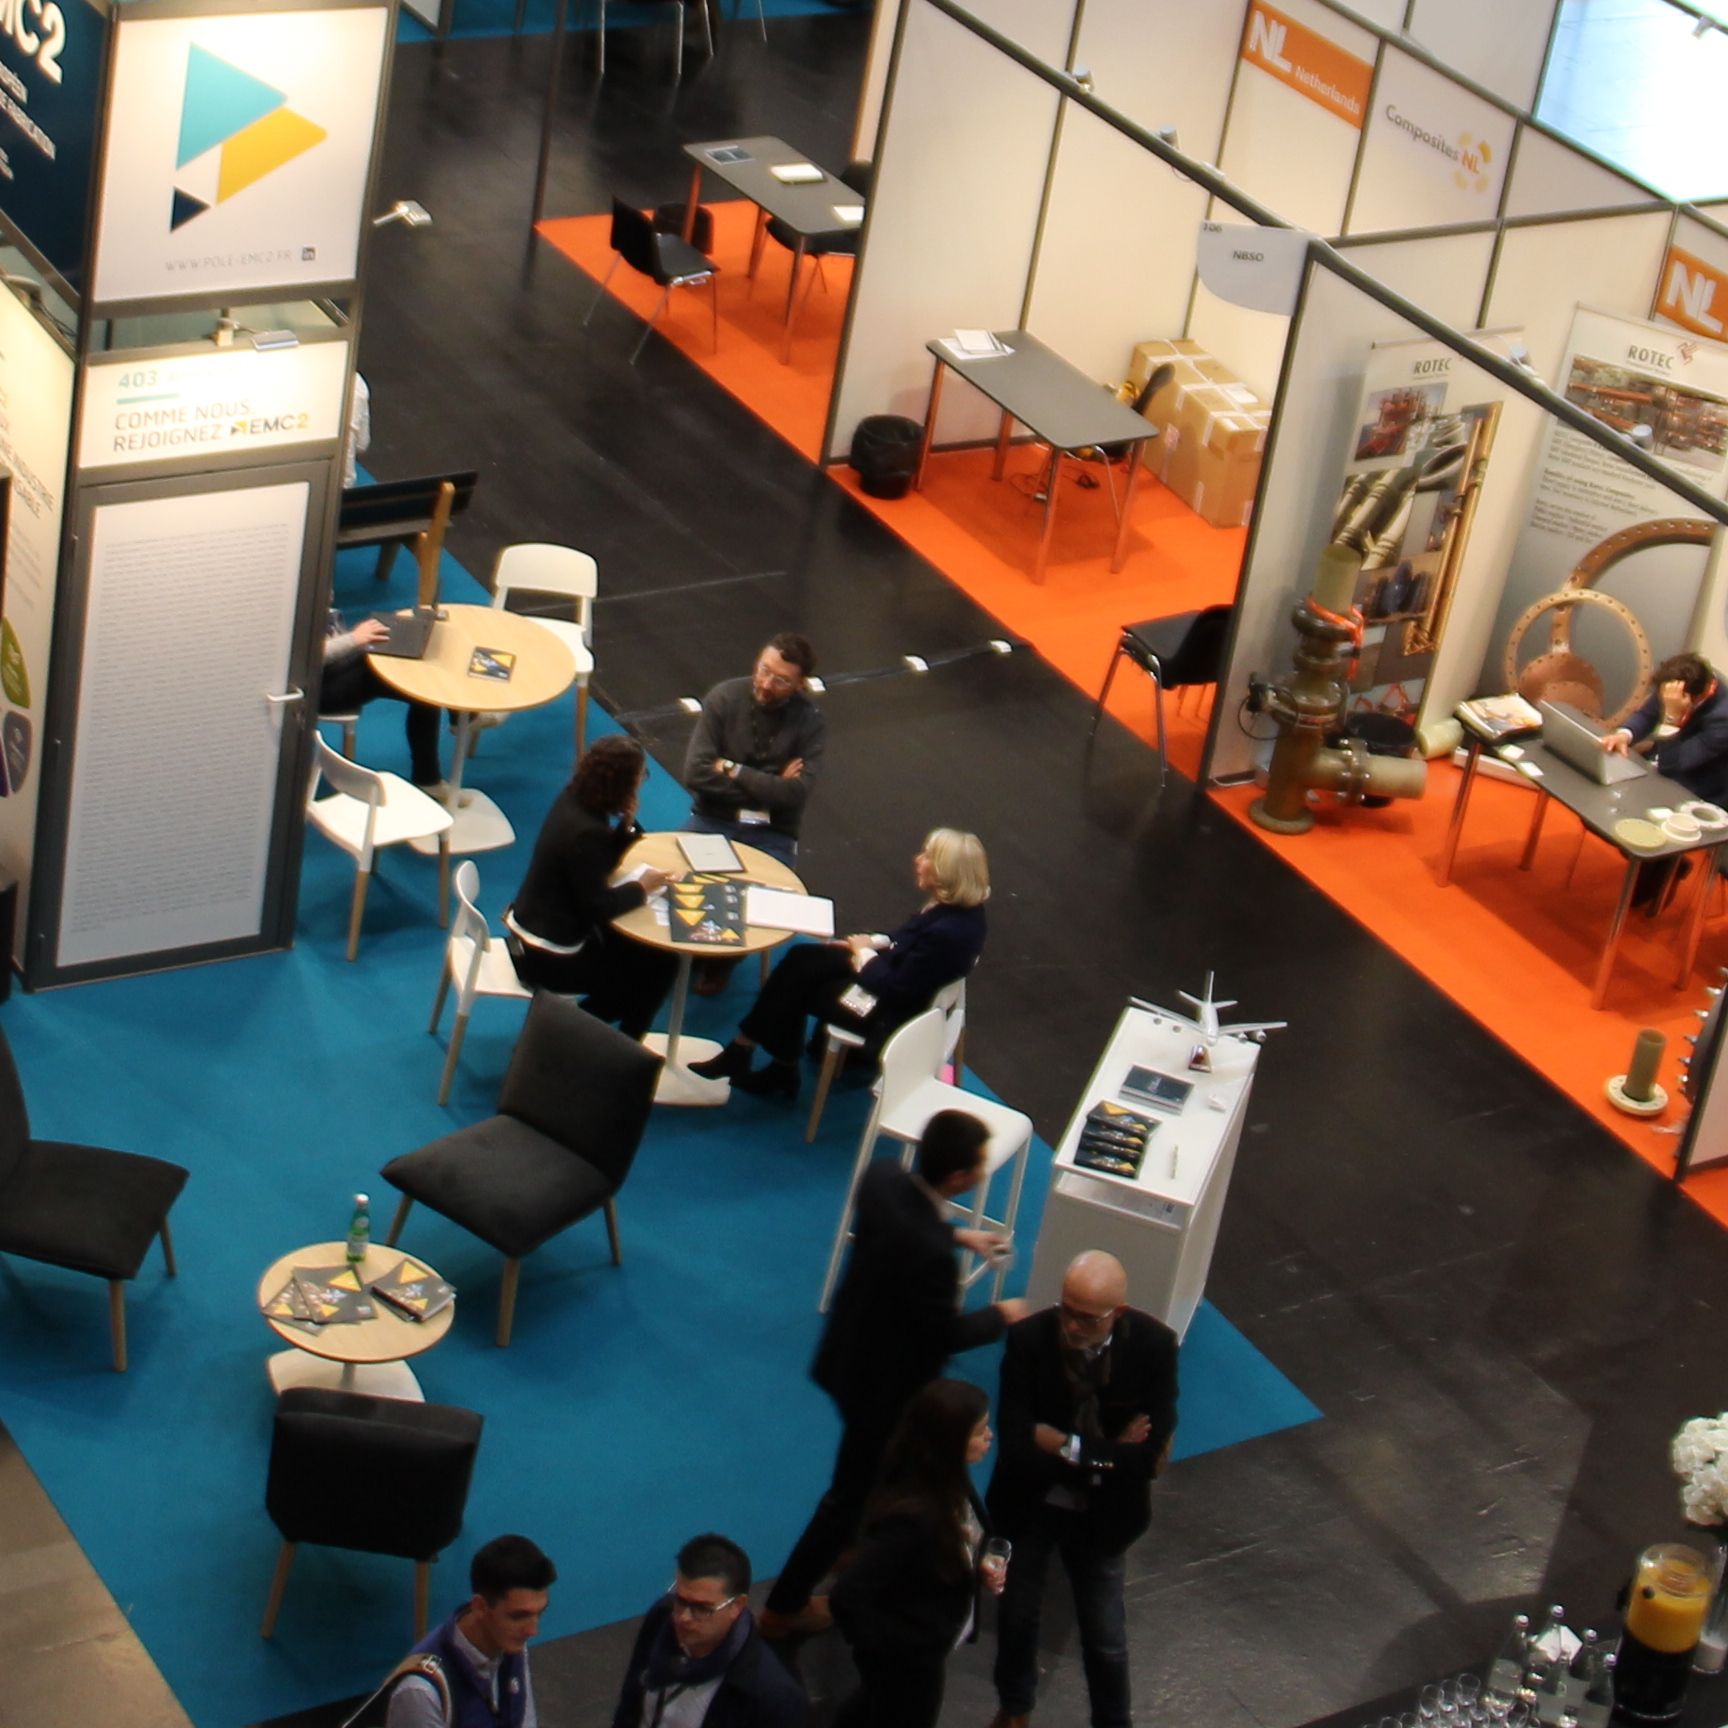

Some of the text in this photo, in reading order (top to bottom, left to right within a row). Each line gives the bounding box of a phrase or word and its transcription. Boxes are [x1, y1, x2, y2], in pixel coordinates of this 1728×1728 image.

[1249, 9, 1360, 116] NL Netherlands
[1385, 103, 1459, 162] Composites
[1666, 260, 1722, 332] NL
[1413, 357, 1452, 375] ROTEC
[1627, 344, 1674, 370] ROTEC
[114, 412, 310, 452] REJOIGNEZ EMC2
[115, 407, 188, 431] COMME
